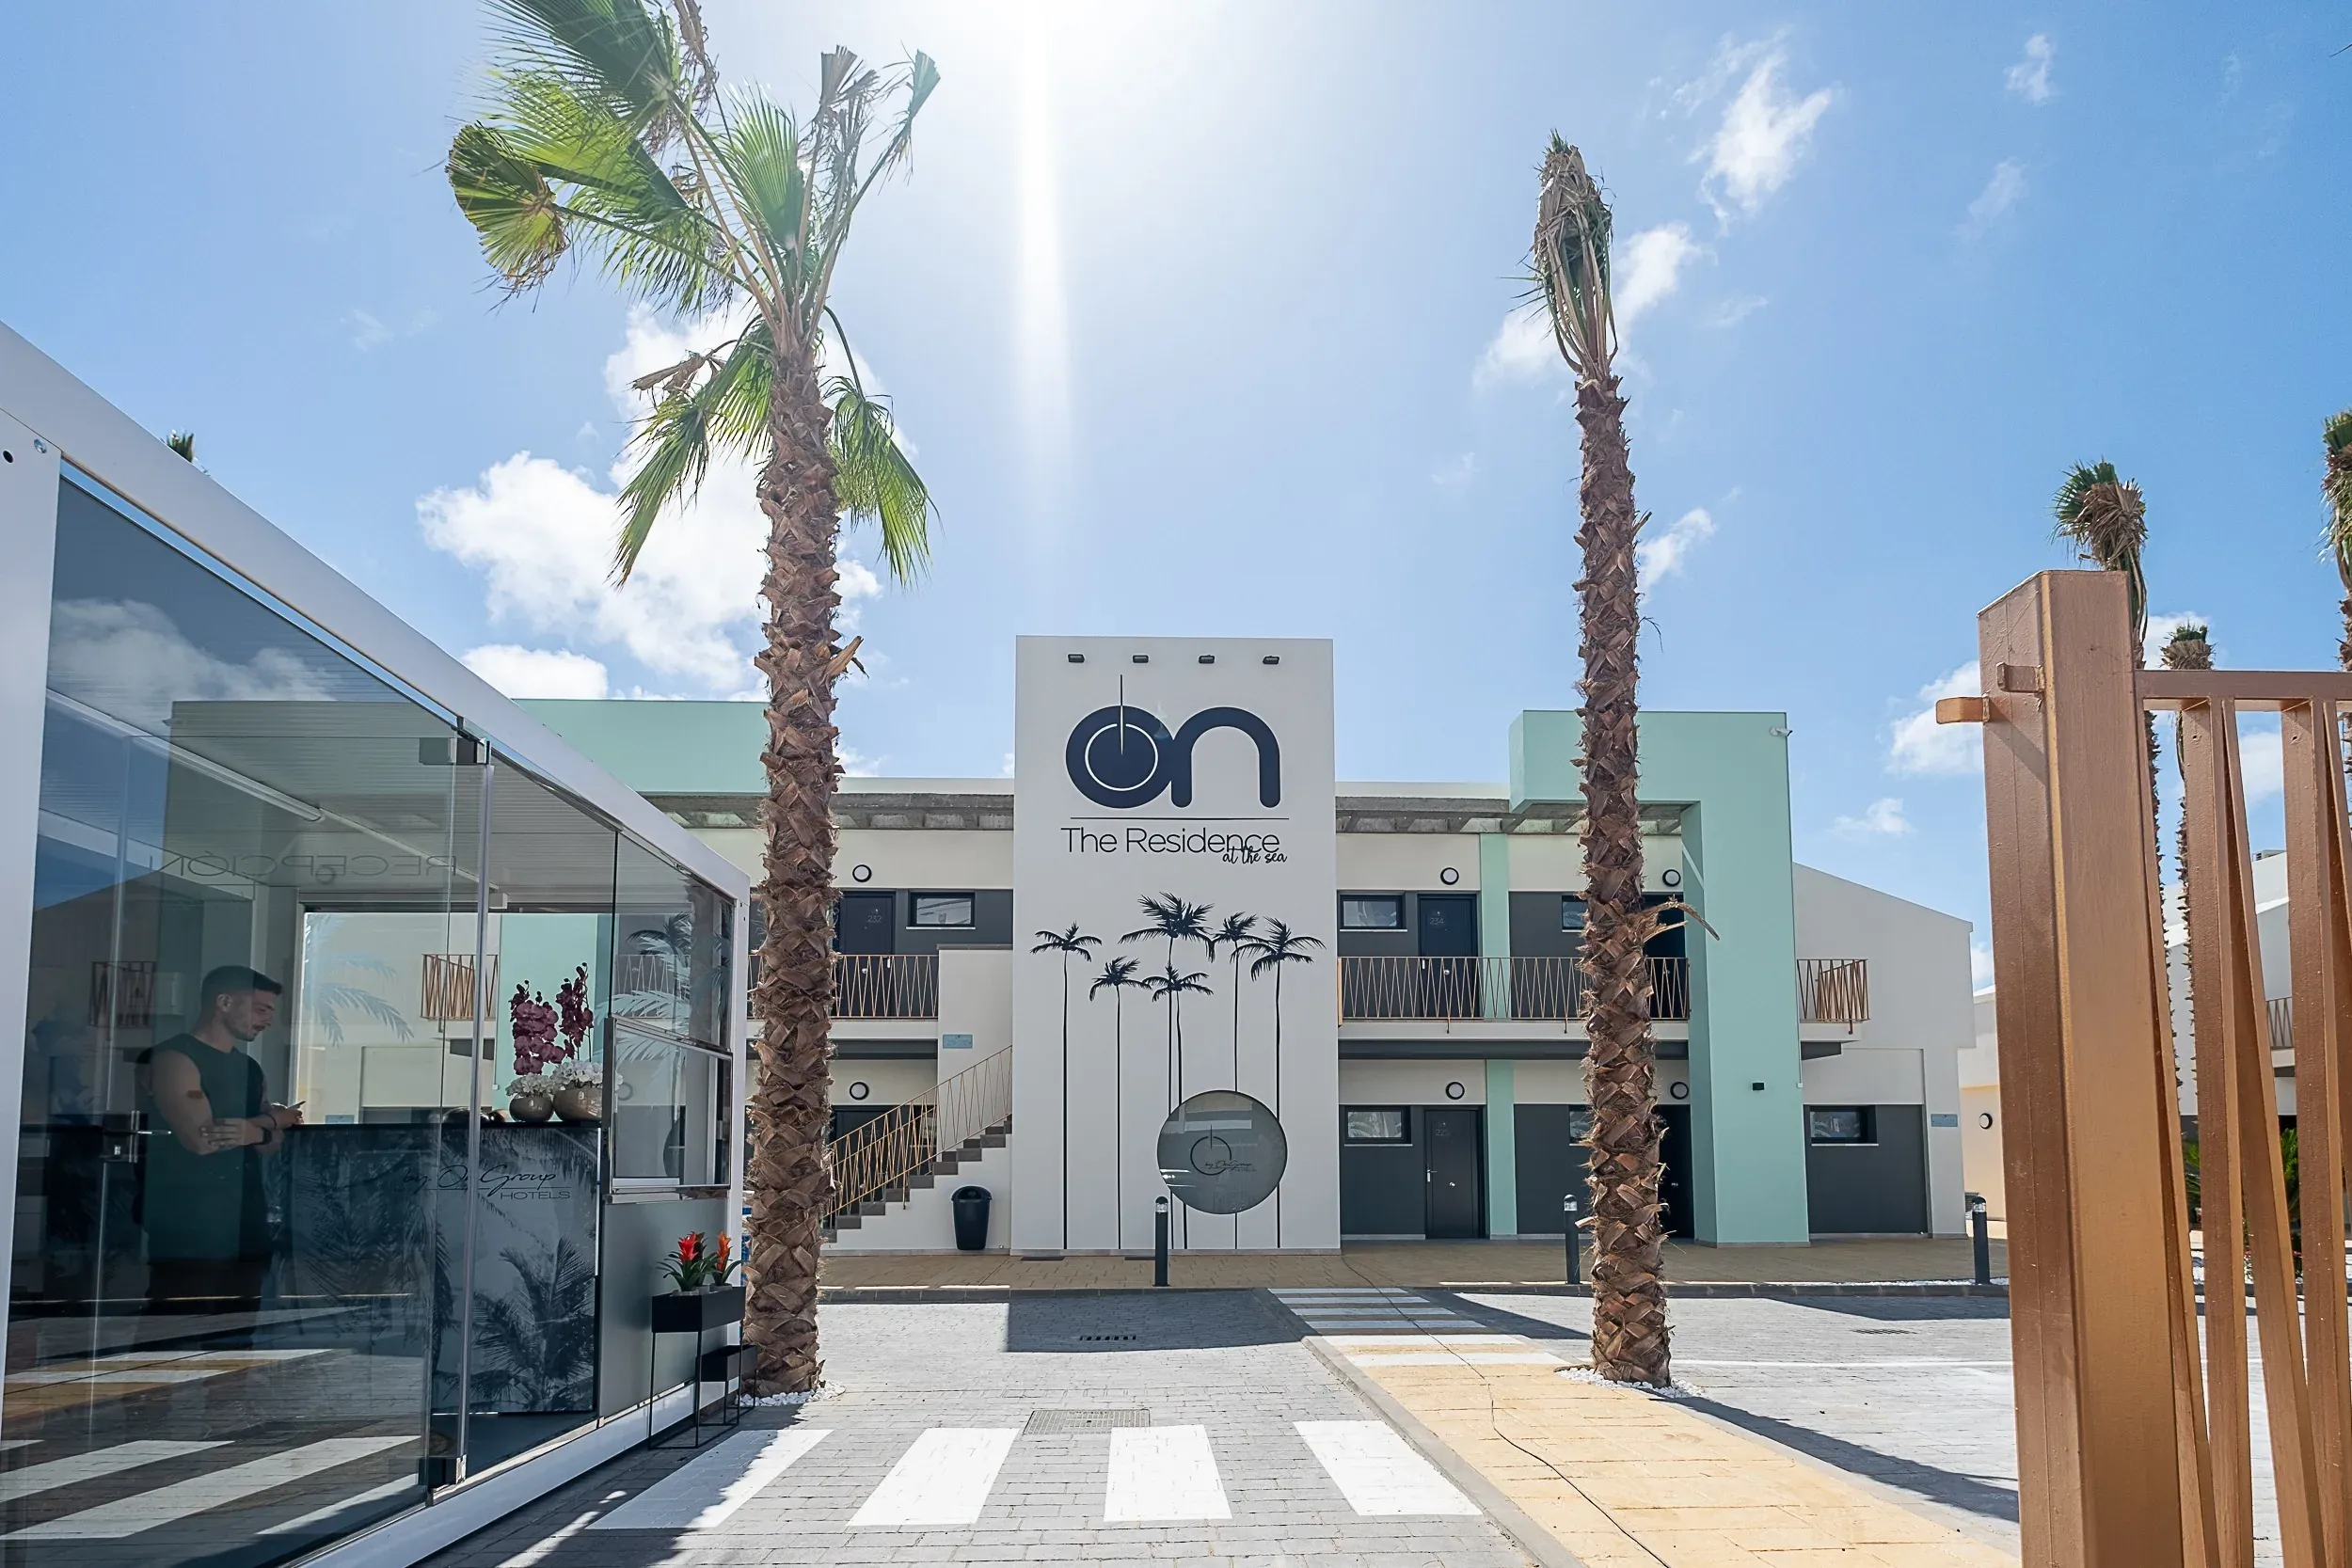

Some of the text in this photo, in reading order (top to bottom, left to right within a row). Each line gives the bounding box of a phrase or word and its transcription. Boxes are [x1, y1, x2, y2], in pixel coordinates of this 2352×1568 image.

[1060, 827, 1280, 853] The Residence
[1222, 845, 1288, 864] at the sea
[402, 1168, 432, 1195] by
[500, 1191, 571, 1200] HOTELS
